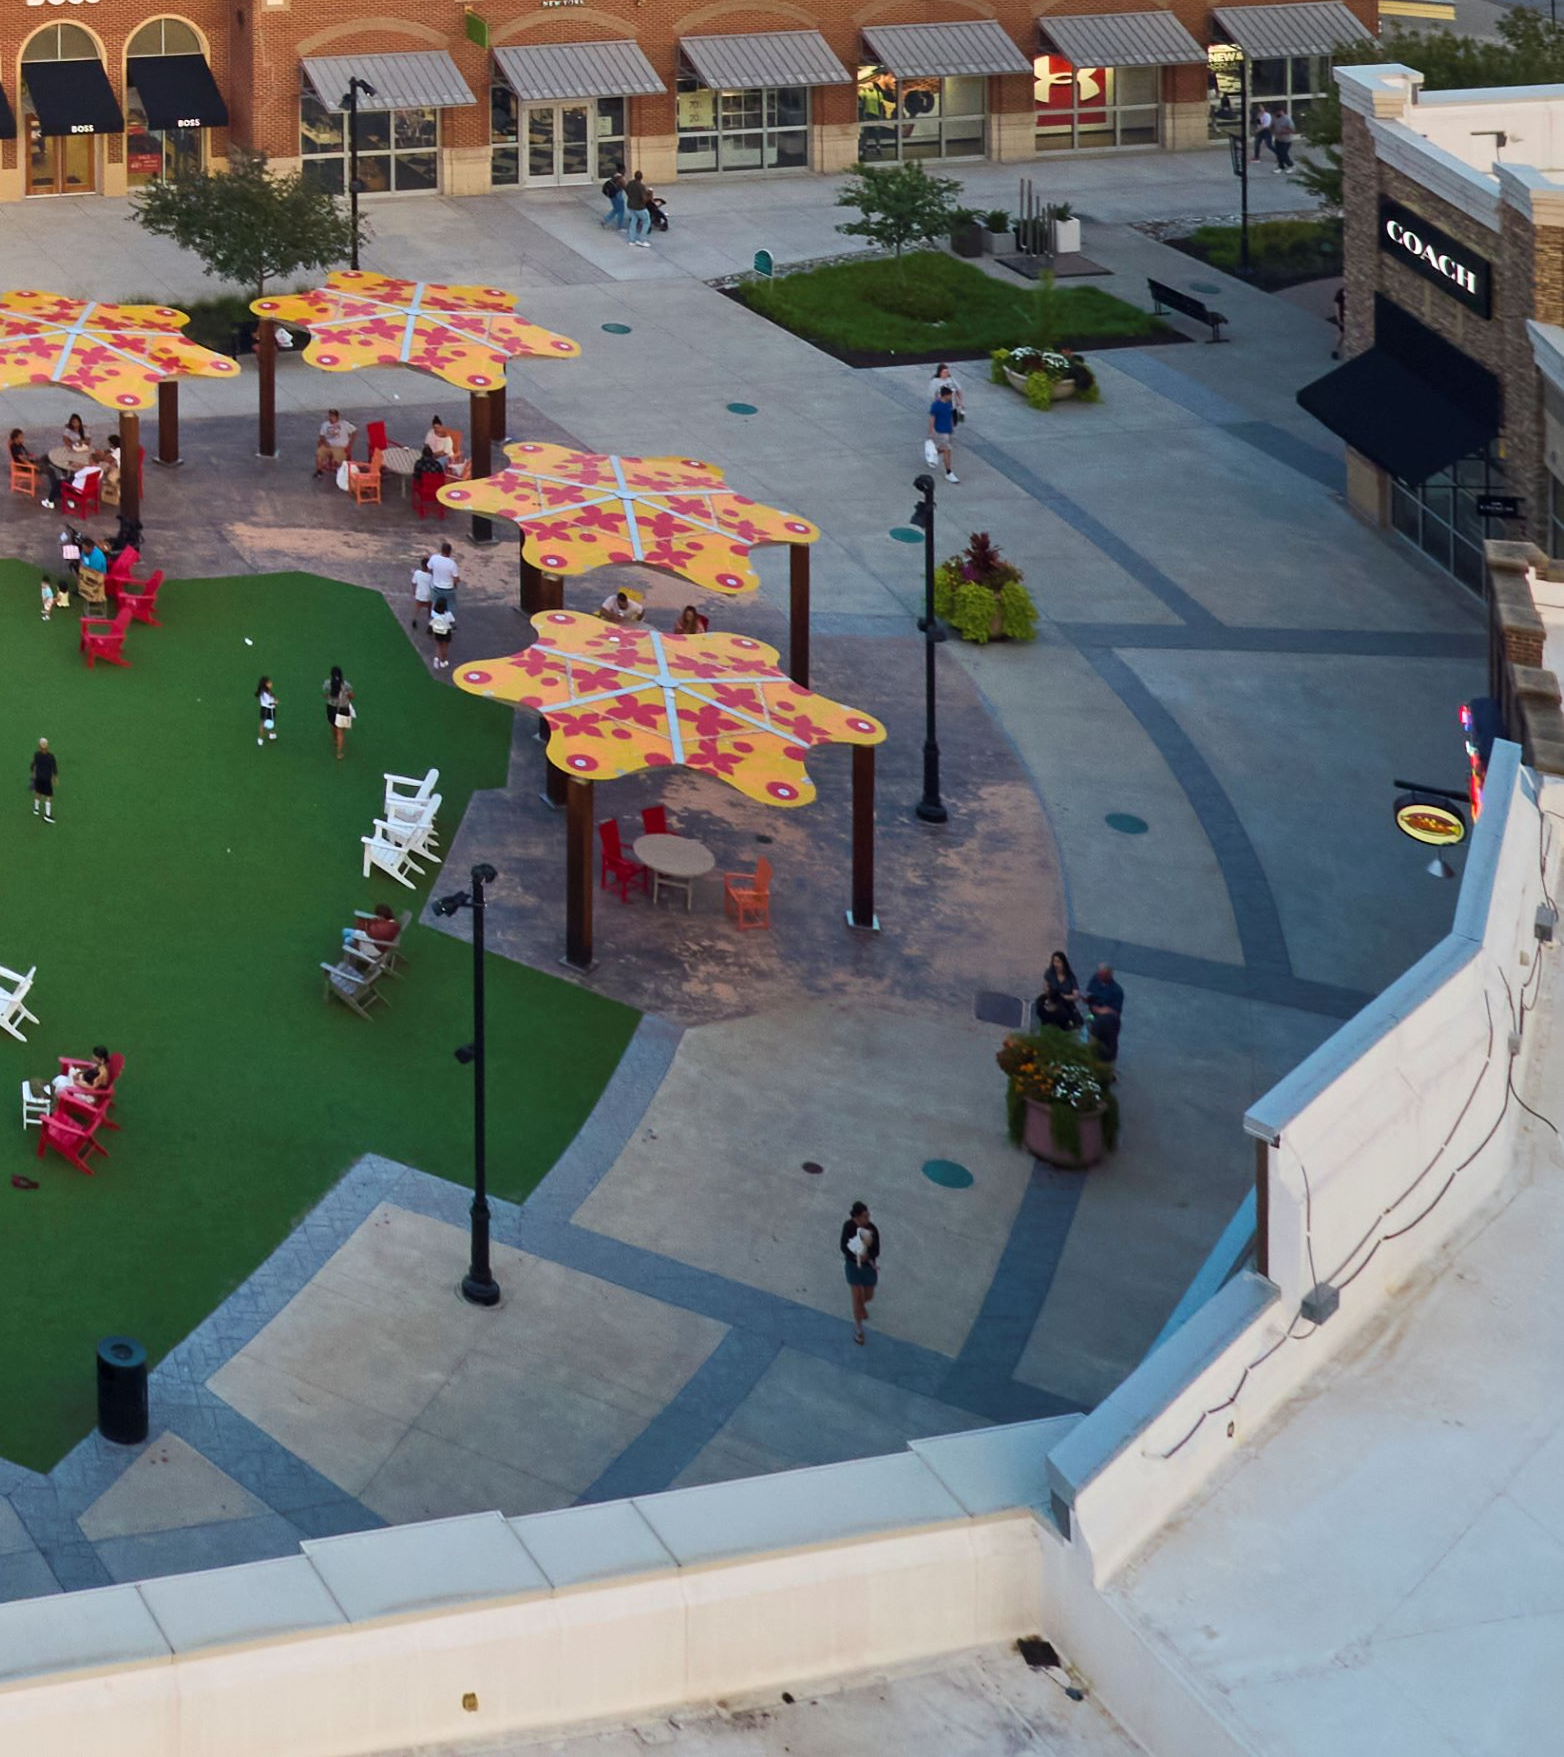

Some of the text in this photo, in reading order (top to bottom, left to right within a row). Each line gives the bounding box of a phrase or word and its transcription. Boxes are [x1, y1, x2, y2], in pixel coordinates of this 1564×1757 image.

[1208, 51, 1235, 62] NEW
[178, 118, 201, 127] BOSS
[71, 124, 94, 133] BOSS
[1386, 220, 1476, 294] COACH
